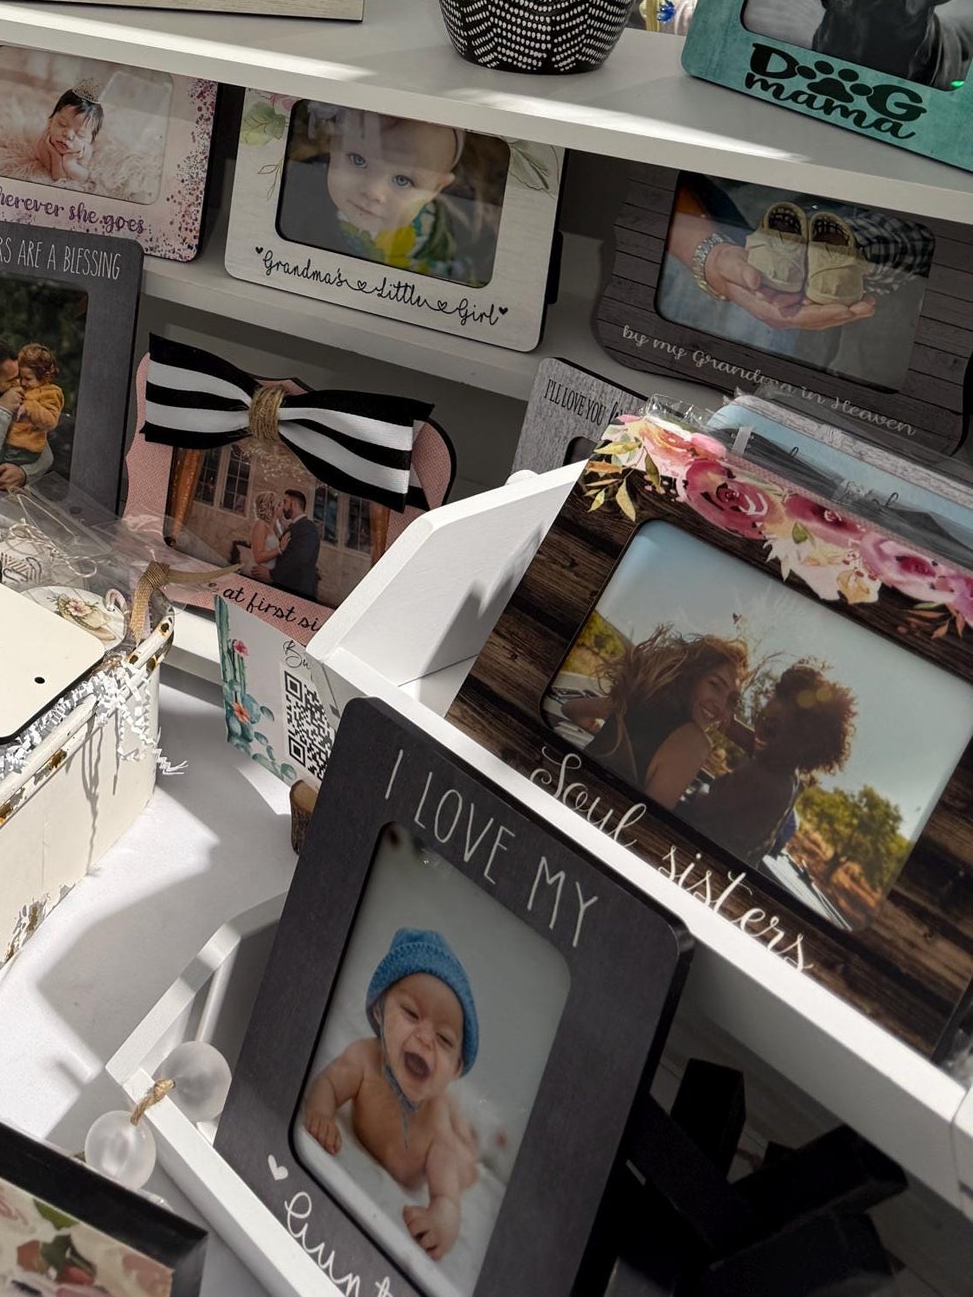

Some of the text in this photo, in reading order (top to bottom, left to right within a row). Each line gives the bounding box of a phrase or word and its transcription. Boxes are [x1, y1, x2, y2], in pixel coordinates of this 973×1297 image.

[745, 72, 916, 140] mama
[68, 202, 97, 224] she
[103, 212, 147, 234] goes
[17, 240, 43, 268] ARE
[47, 244, 57, 271] A
[63, 248, 122, 280] BLESSING
[263, 250, 499, 326] Grandma's Little Girl
[623, 324, 649, 348] by
[800, 382, 827, 405] in
[561, 387, 587, 416] LOVE
[585, 398, 607, 426] YOU
[222, 586, 247, 603] at
[246, 592, 297, 622] first
[385, 749, 599, 948] I LOVE MY
[529, 746, 814, 974] Soul sisters
